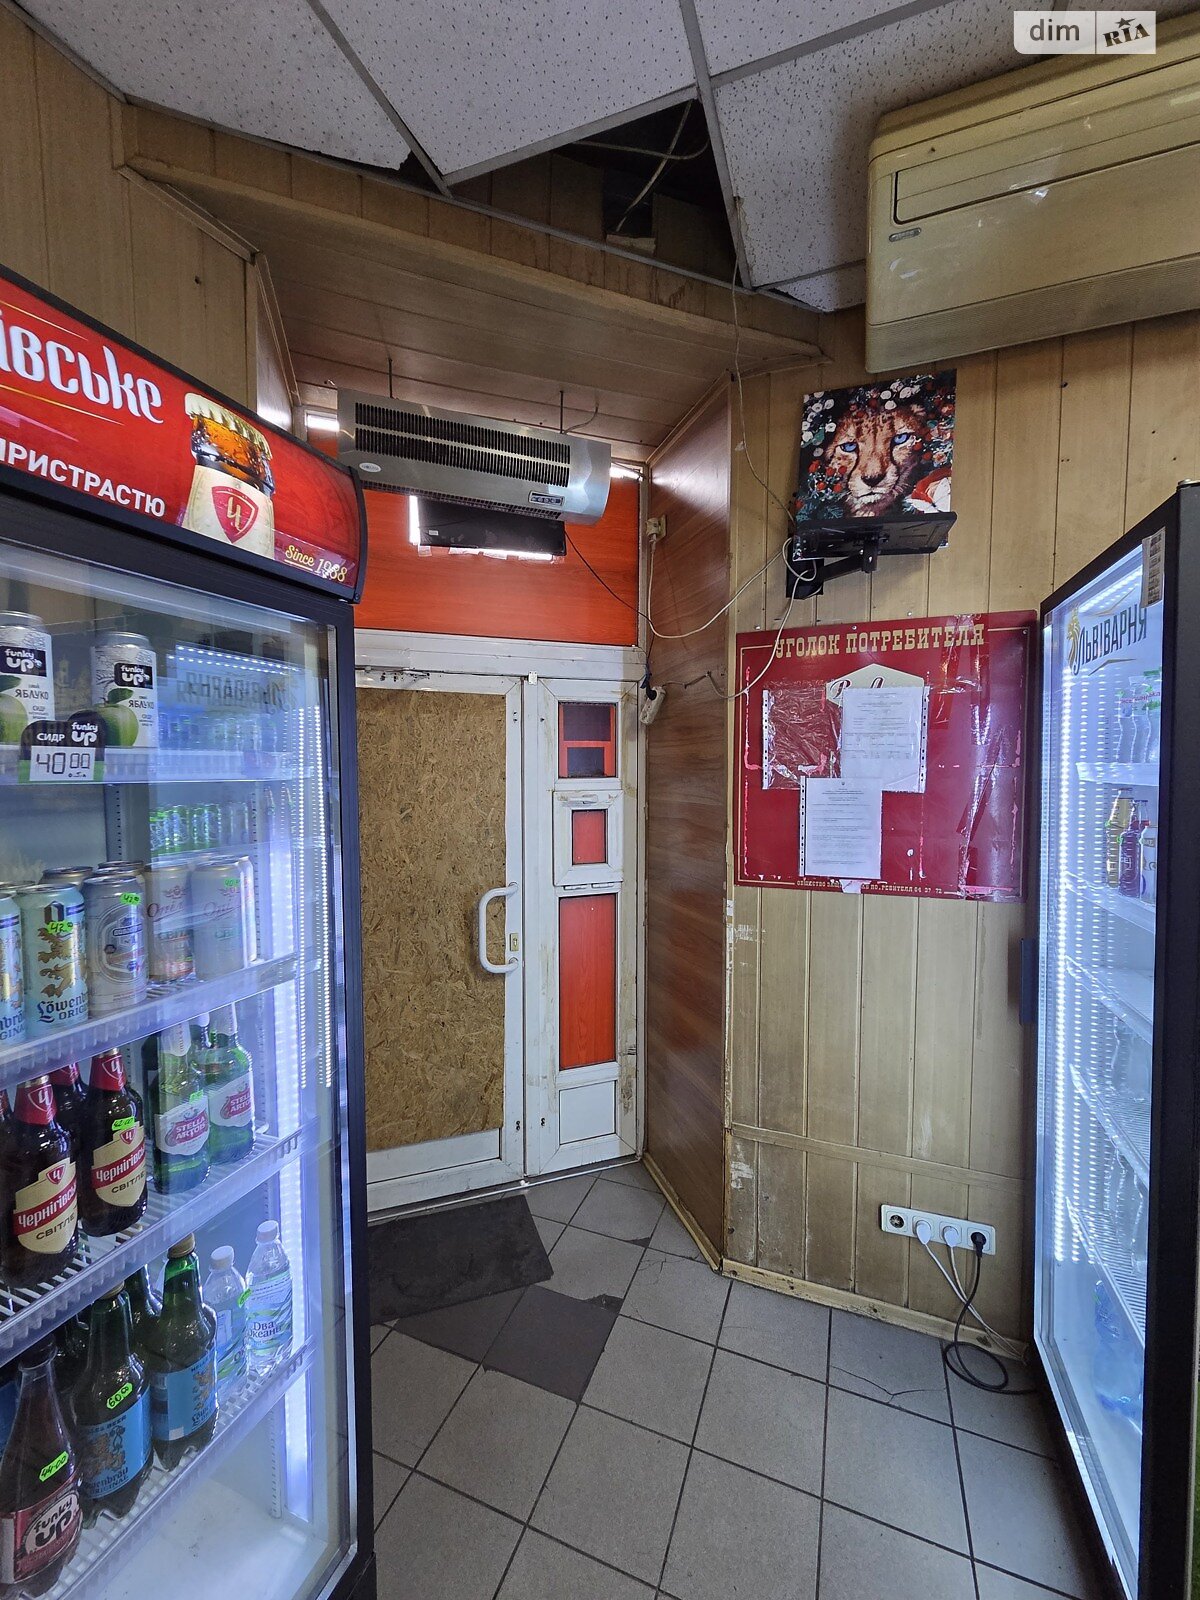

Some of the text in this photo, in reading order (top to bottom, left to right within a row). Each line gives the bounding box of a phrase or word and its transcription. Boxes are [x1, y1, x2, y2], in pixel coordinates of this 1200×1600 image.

[285, 545, 314, 567] Since
[775, 623, 985, 659] УГОЛОК ПОТРЕБИТЕЛЯ
[1073, 603, 1148, 676] ЛЬВІВАРНЯ
[5, 648, 35, 660] funky
[121, 665, 144, 675] funky
[15, 688, 49, 700] ЯБЛУКО
[71, 721, 98, 733] funky
[36, 732, 66, 743] СИДР
[71, 730, 98, 747] up
[176, 1116, 205, 1132] STELLA
[35, 1213, 75, 1240] СВІТЛЕ
[34, 1497, 72, 1533] funky
